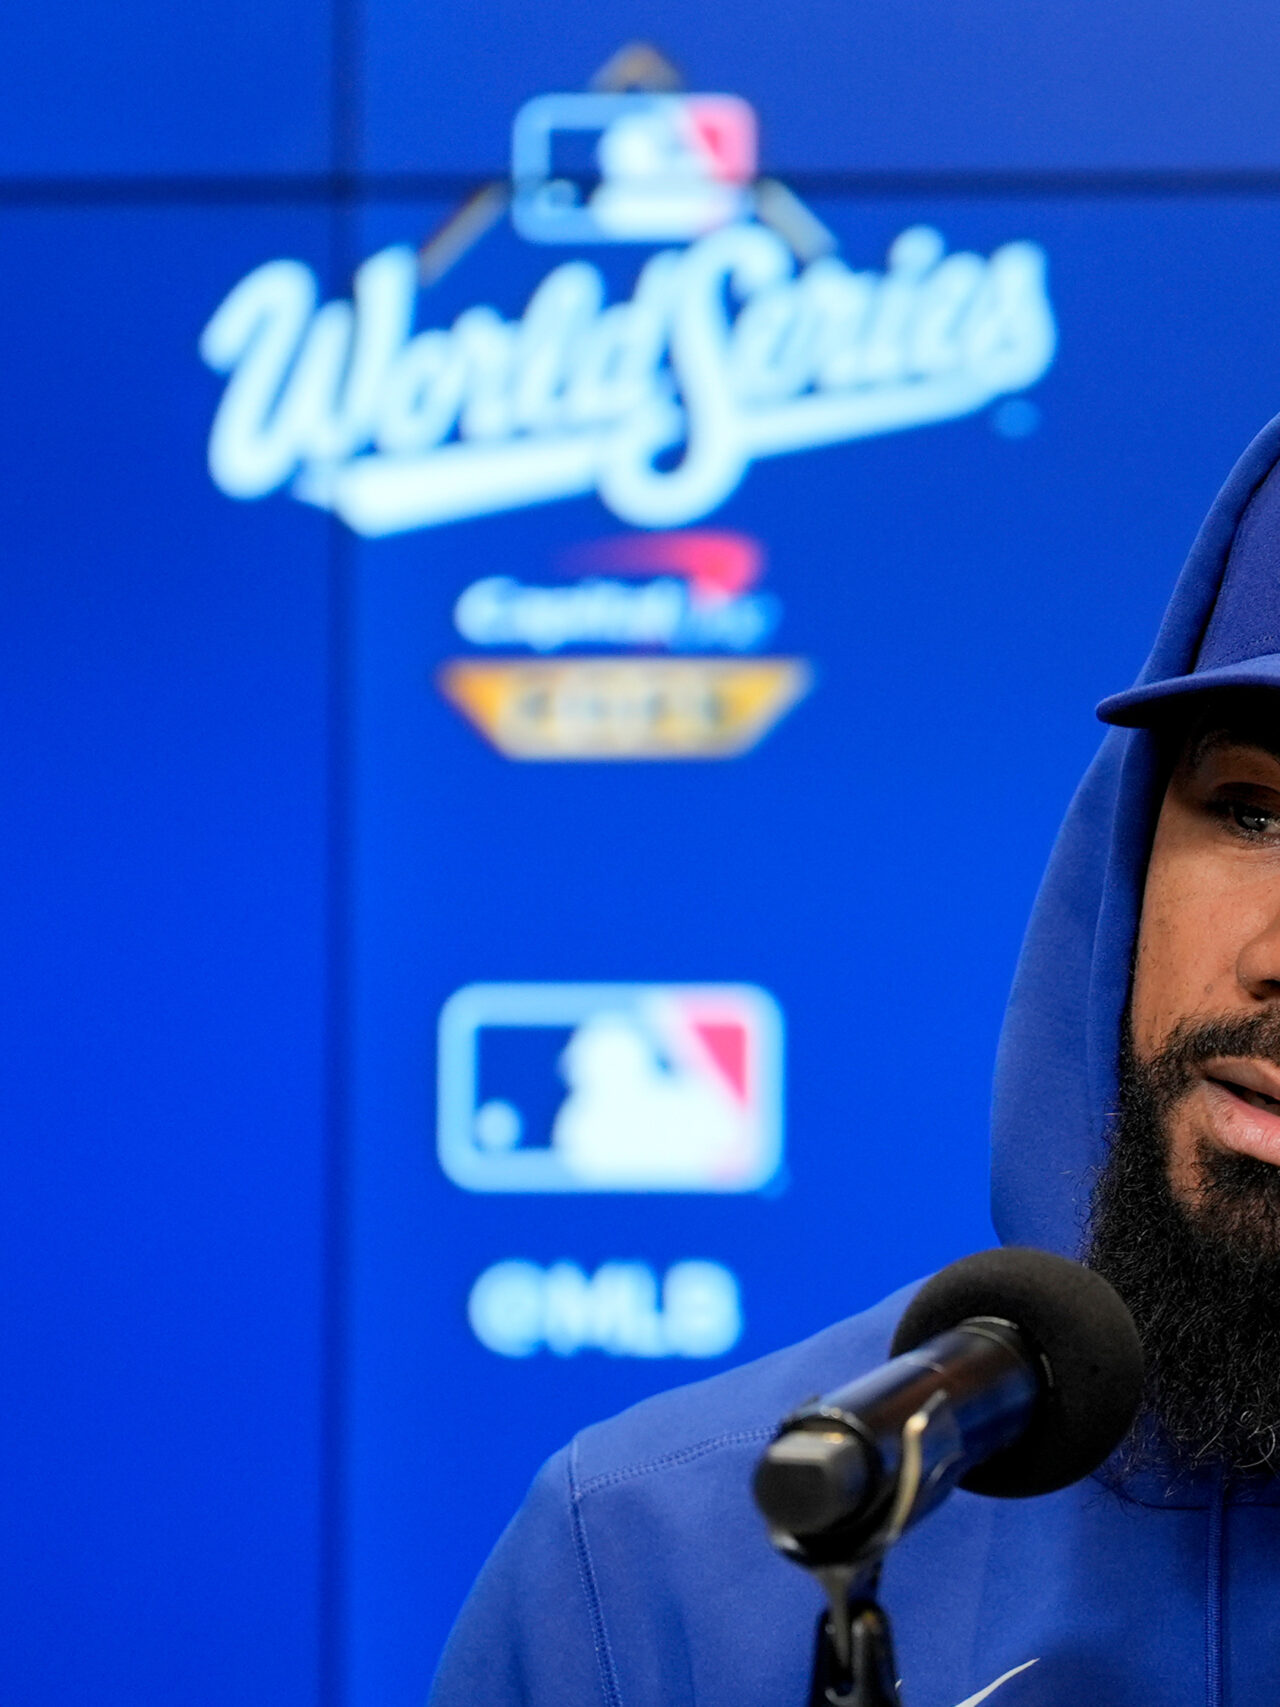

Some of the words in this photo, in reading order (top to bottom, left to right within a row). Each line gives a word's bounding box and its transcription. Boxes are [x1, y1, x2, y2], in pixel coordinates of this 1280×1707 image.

[200, 243, 690, 500] World
[600, 222, 1057, 529] Series
[467, 1257, 744, 1358] @MLB
